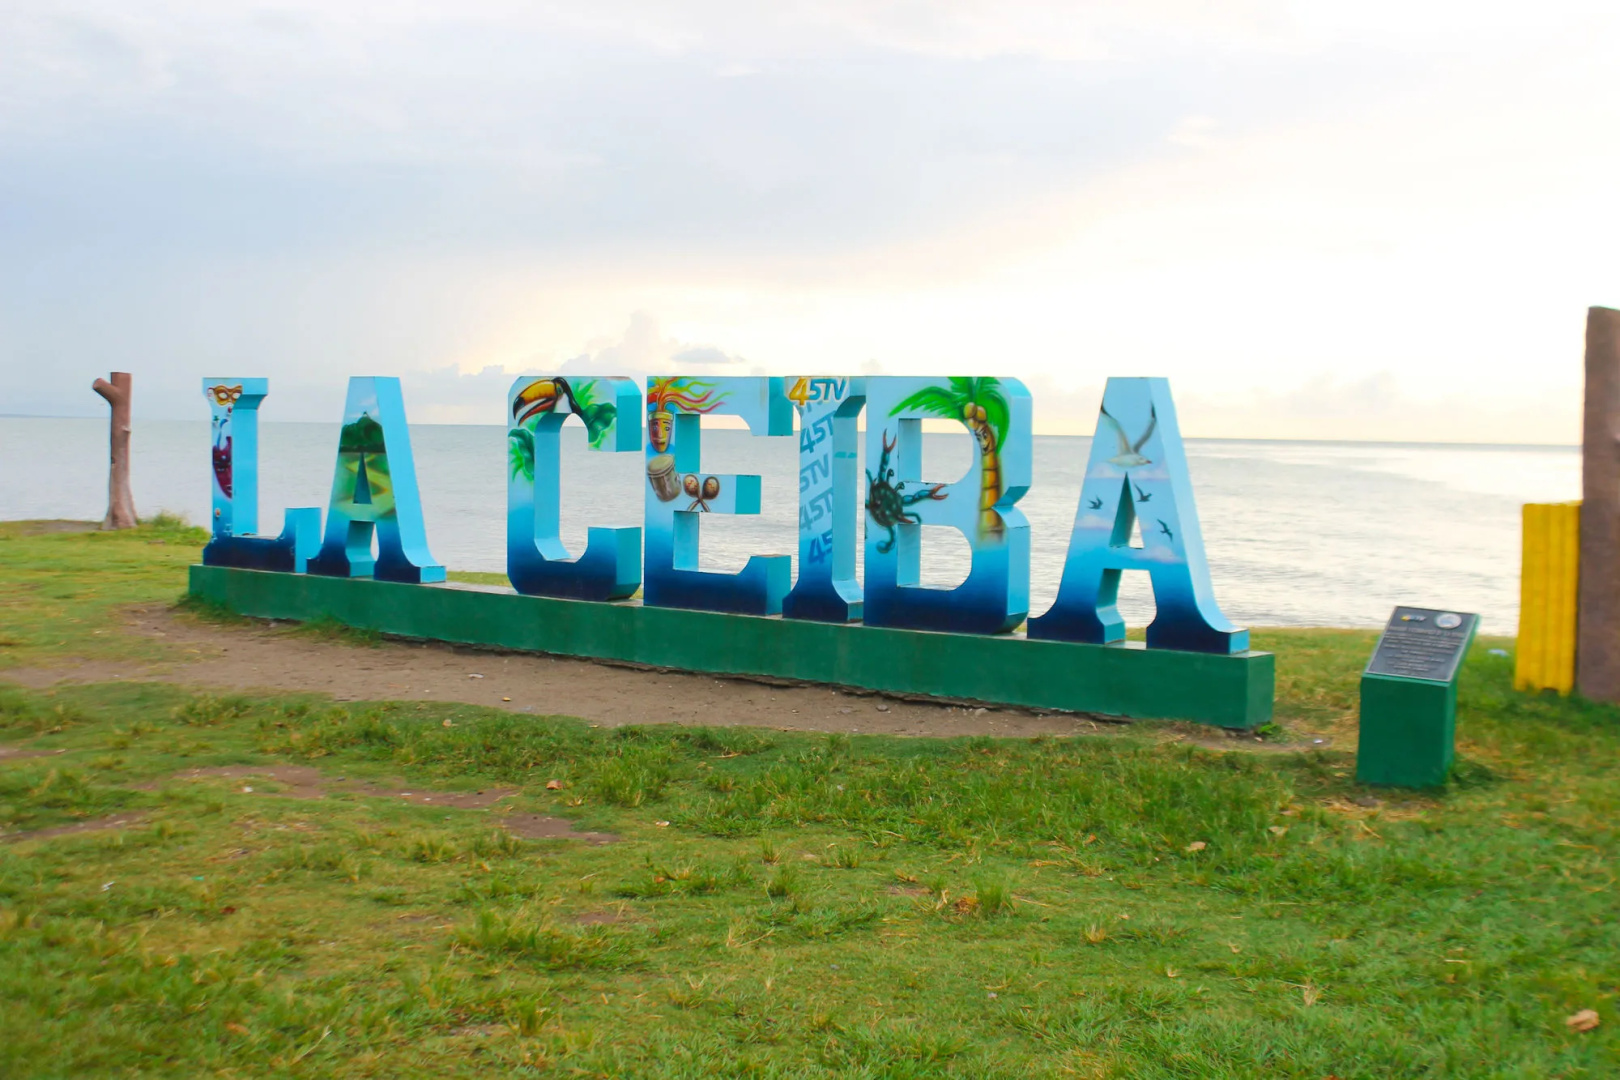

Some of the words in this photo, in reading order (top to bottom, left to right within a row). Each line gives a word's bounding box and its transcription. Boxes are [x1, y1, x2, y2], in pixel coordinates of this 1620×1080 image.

[789, 377, 846, 406] 45TV
[202, 376, 447, 584] LA
[507, 376, 1250, 655] CEIBA
